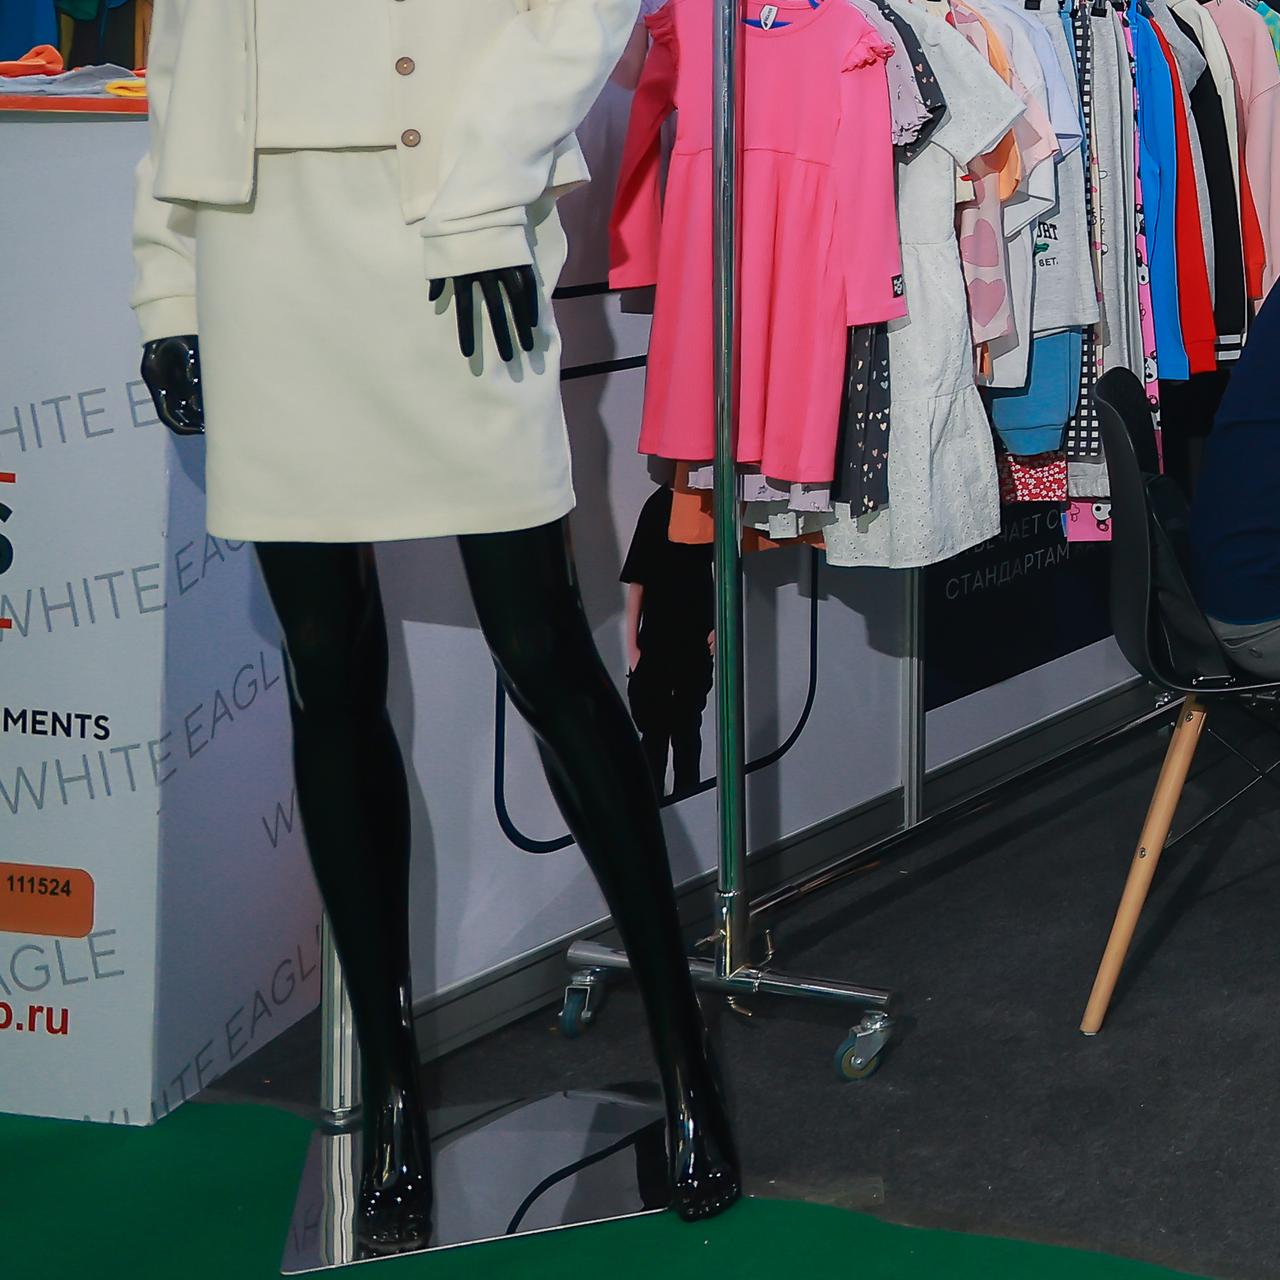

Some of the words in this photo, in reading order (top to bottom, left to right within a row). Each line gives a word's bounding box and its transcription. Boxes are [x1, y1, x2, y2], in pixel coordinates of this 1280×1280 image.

[945, 542, 1070, 600] СТАНДАРТАМ
[0, 732, 176, 814] WHITE
[185, 651, 280, 758] EAGL
[3, 707, 110, 741] MENTS
[7, 875, 72, 897] 111524
